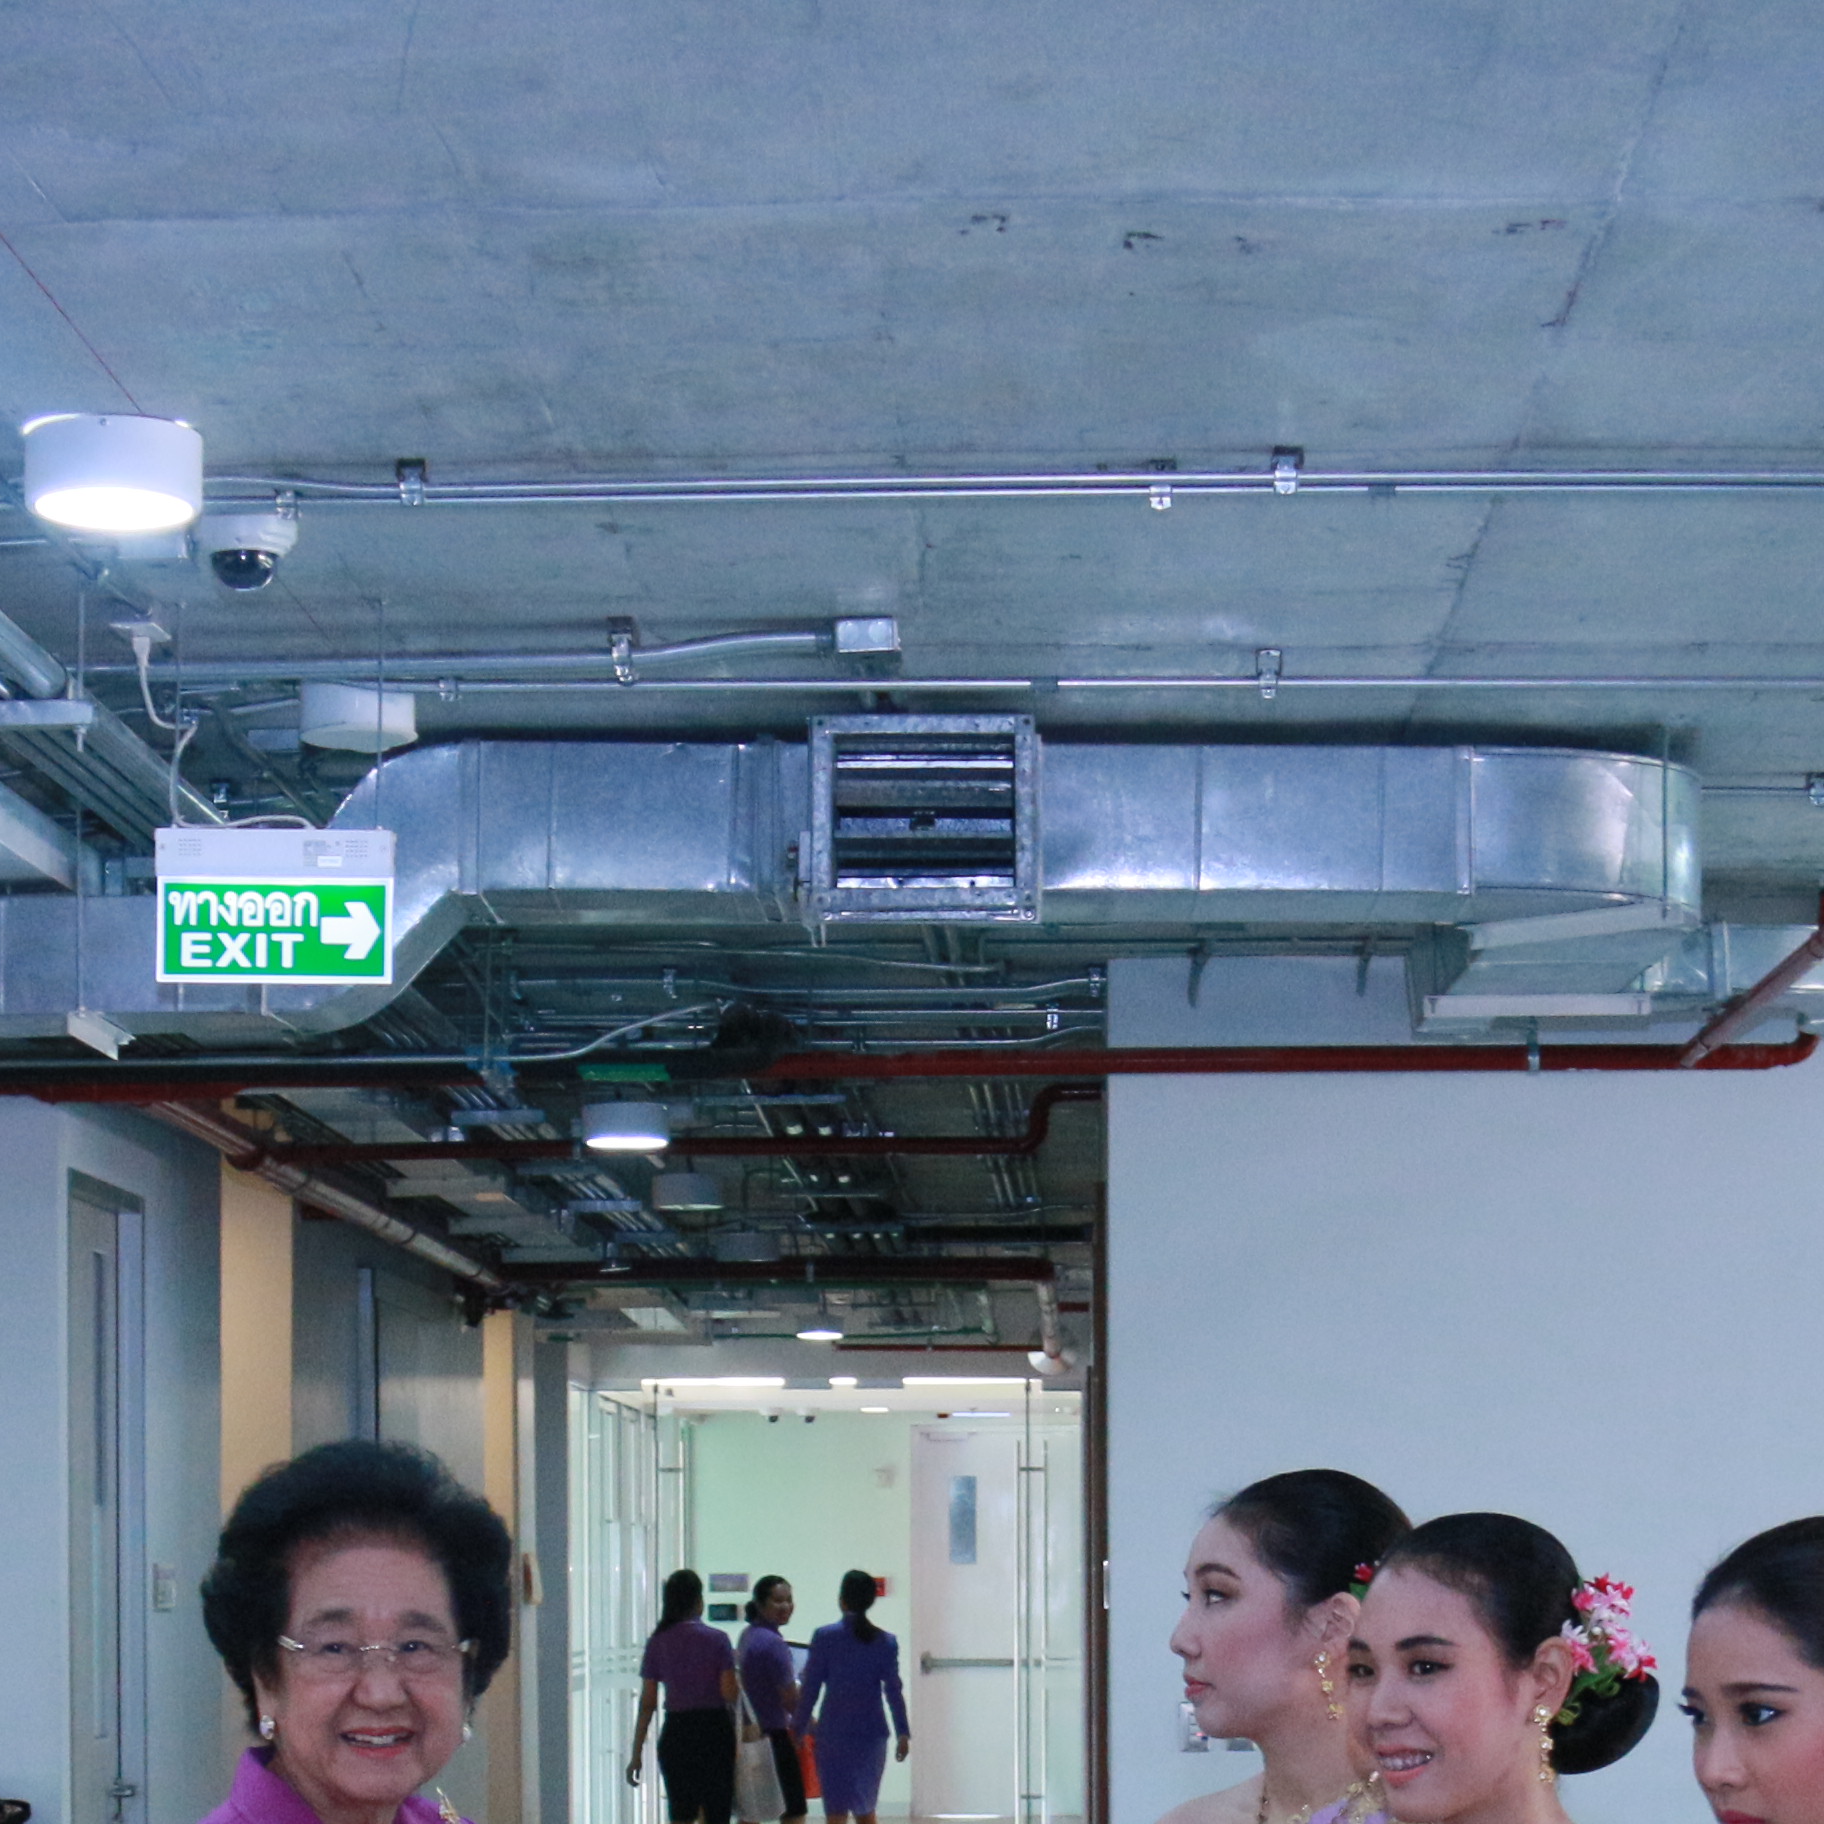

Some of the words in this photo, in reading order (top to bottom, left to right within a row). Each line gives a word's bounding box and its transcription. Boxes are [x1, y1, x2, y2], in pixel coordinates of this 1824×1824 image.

[168, 890, 318, 927] ทางออก
[180, 932, 304, 968] EXIT
